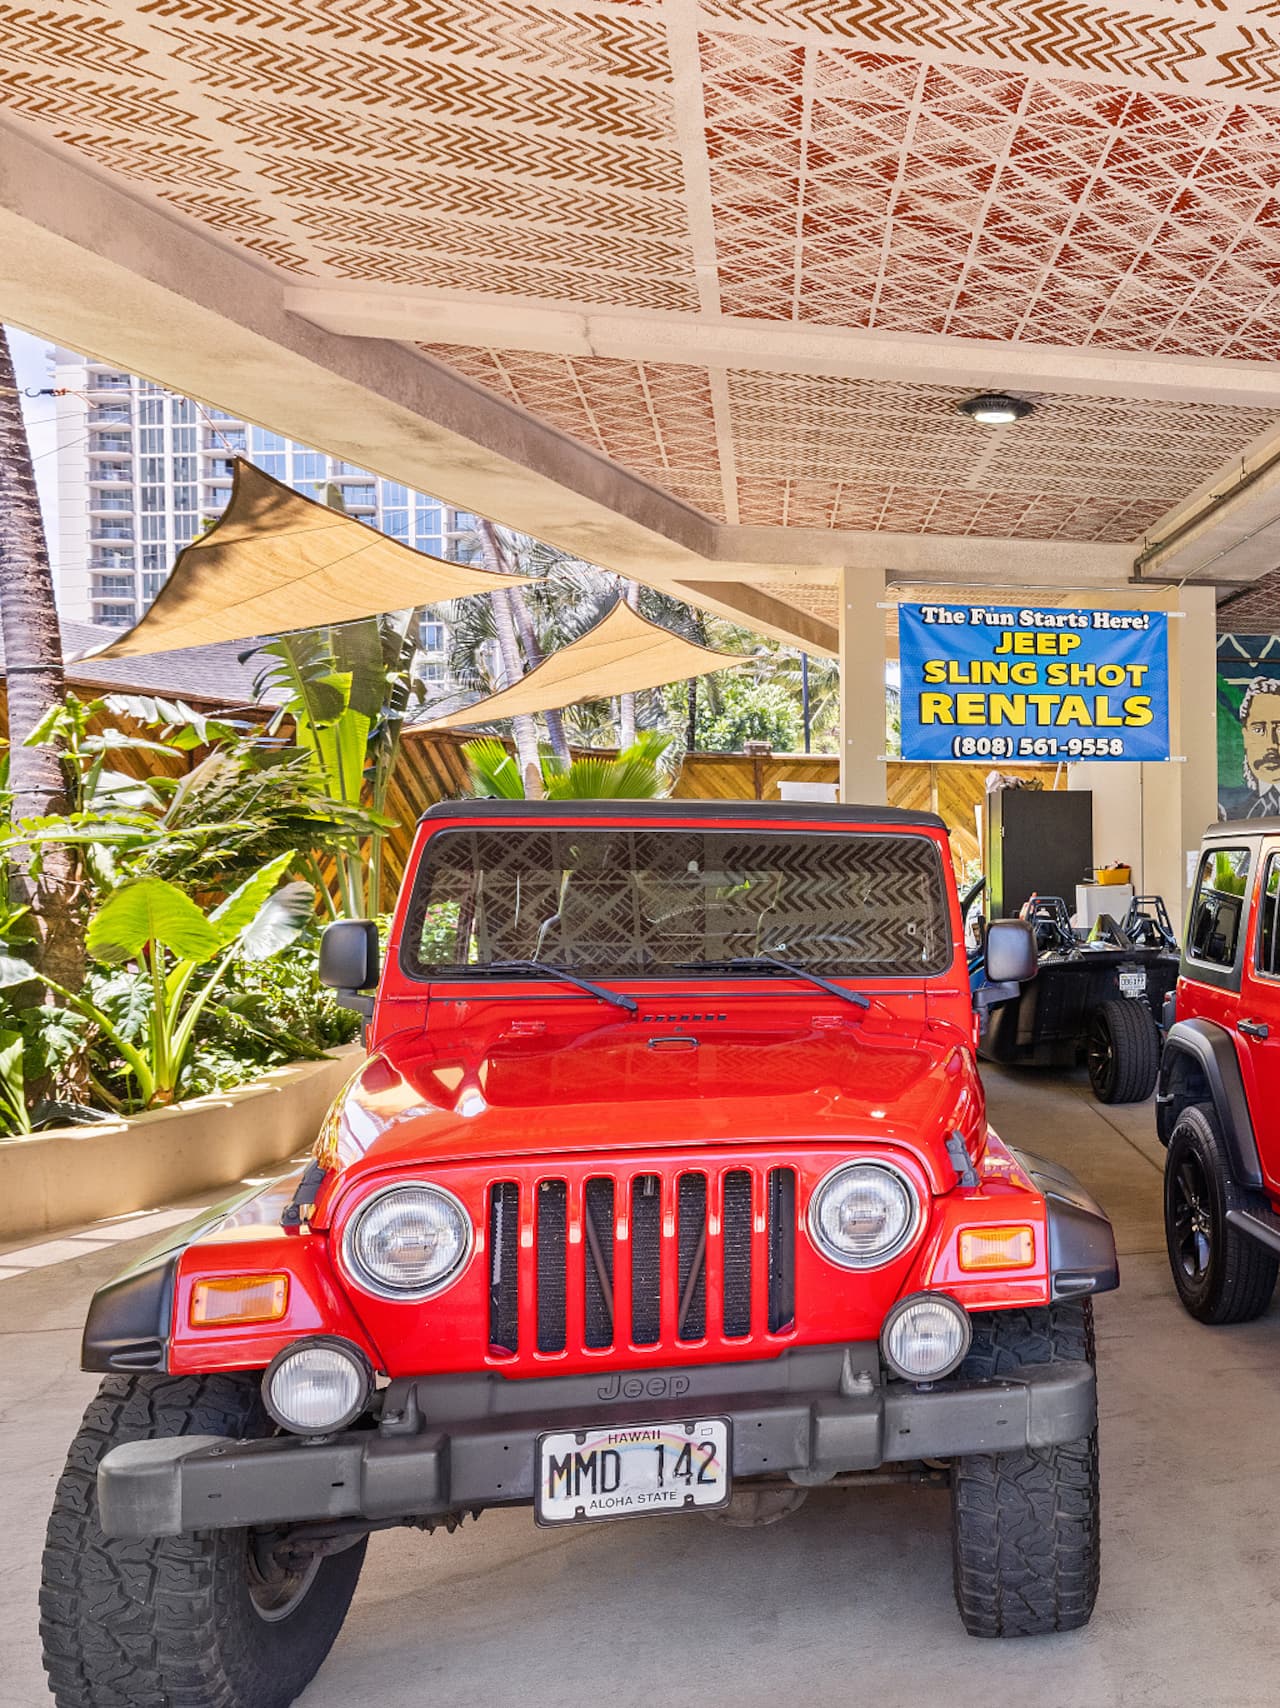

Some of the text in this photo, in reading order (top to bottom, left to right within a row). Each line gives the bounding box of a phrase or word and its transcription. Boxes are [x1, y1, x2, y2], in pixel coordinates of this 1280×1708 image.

[921, 606, 1150, 630] The Fun Starts Here!
[994, 631, 1081, 655] JEEP
[922, 660, 1149, 687] SLING SHOT
[920, 692, 1154, 727] RENTALS
[953, 735, 1124, 758] (808) 561-9558
[597, 1375, 690, 1401] Jeep
[608, 1430, 661, 1444] HAWAII
[549, 1441, 718, 1499] MMD 142
[589, 1491, 678, 1510] ALOHA STATE
